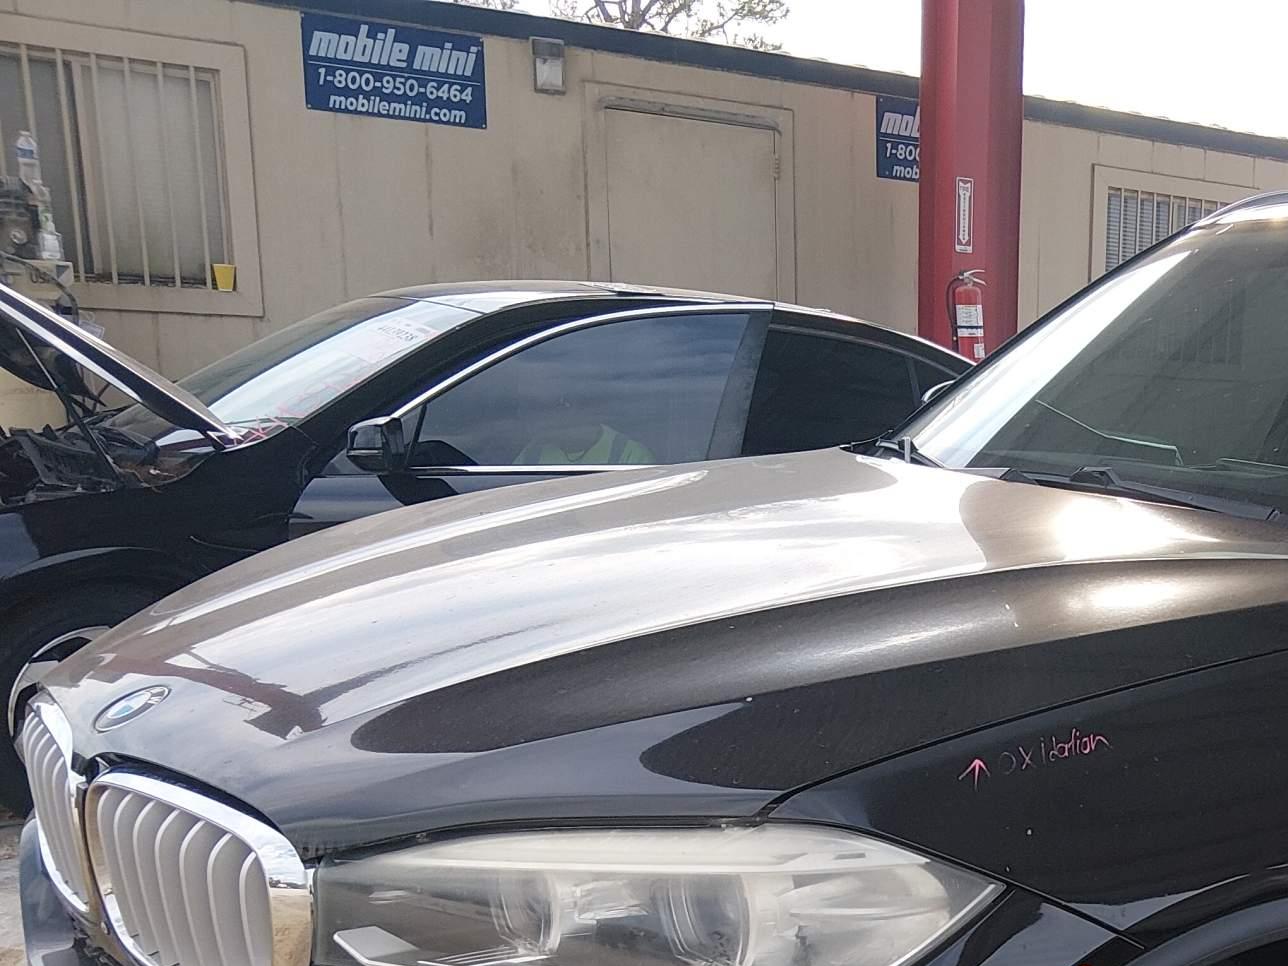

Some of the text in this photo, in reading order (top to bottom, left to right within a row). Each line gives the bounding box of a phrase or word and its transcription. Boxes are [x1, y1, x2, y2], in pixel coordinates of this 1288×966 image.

[309, 24, 478, 77] mobile mini
[318, 67, 473, 104] 1-800-950-6464
[329, 94, 466, 124] mobilemini.com
